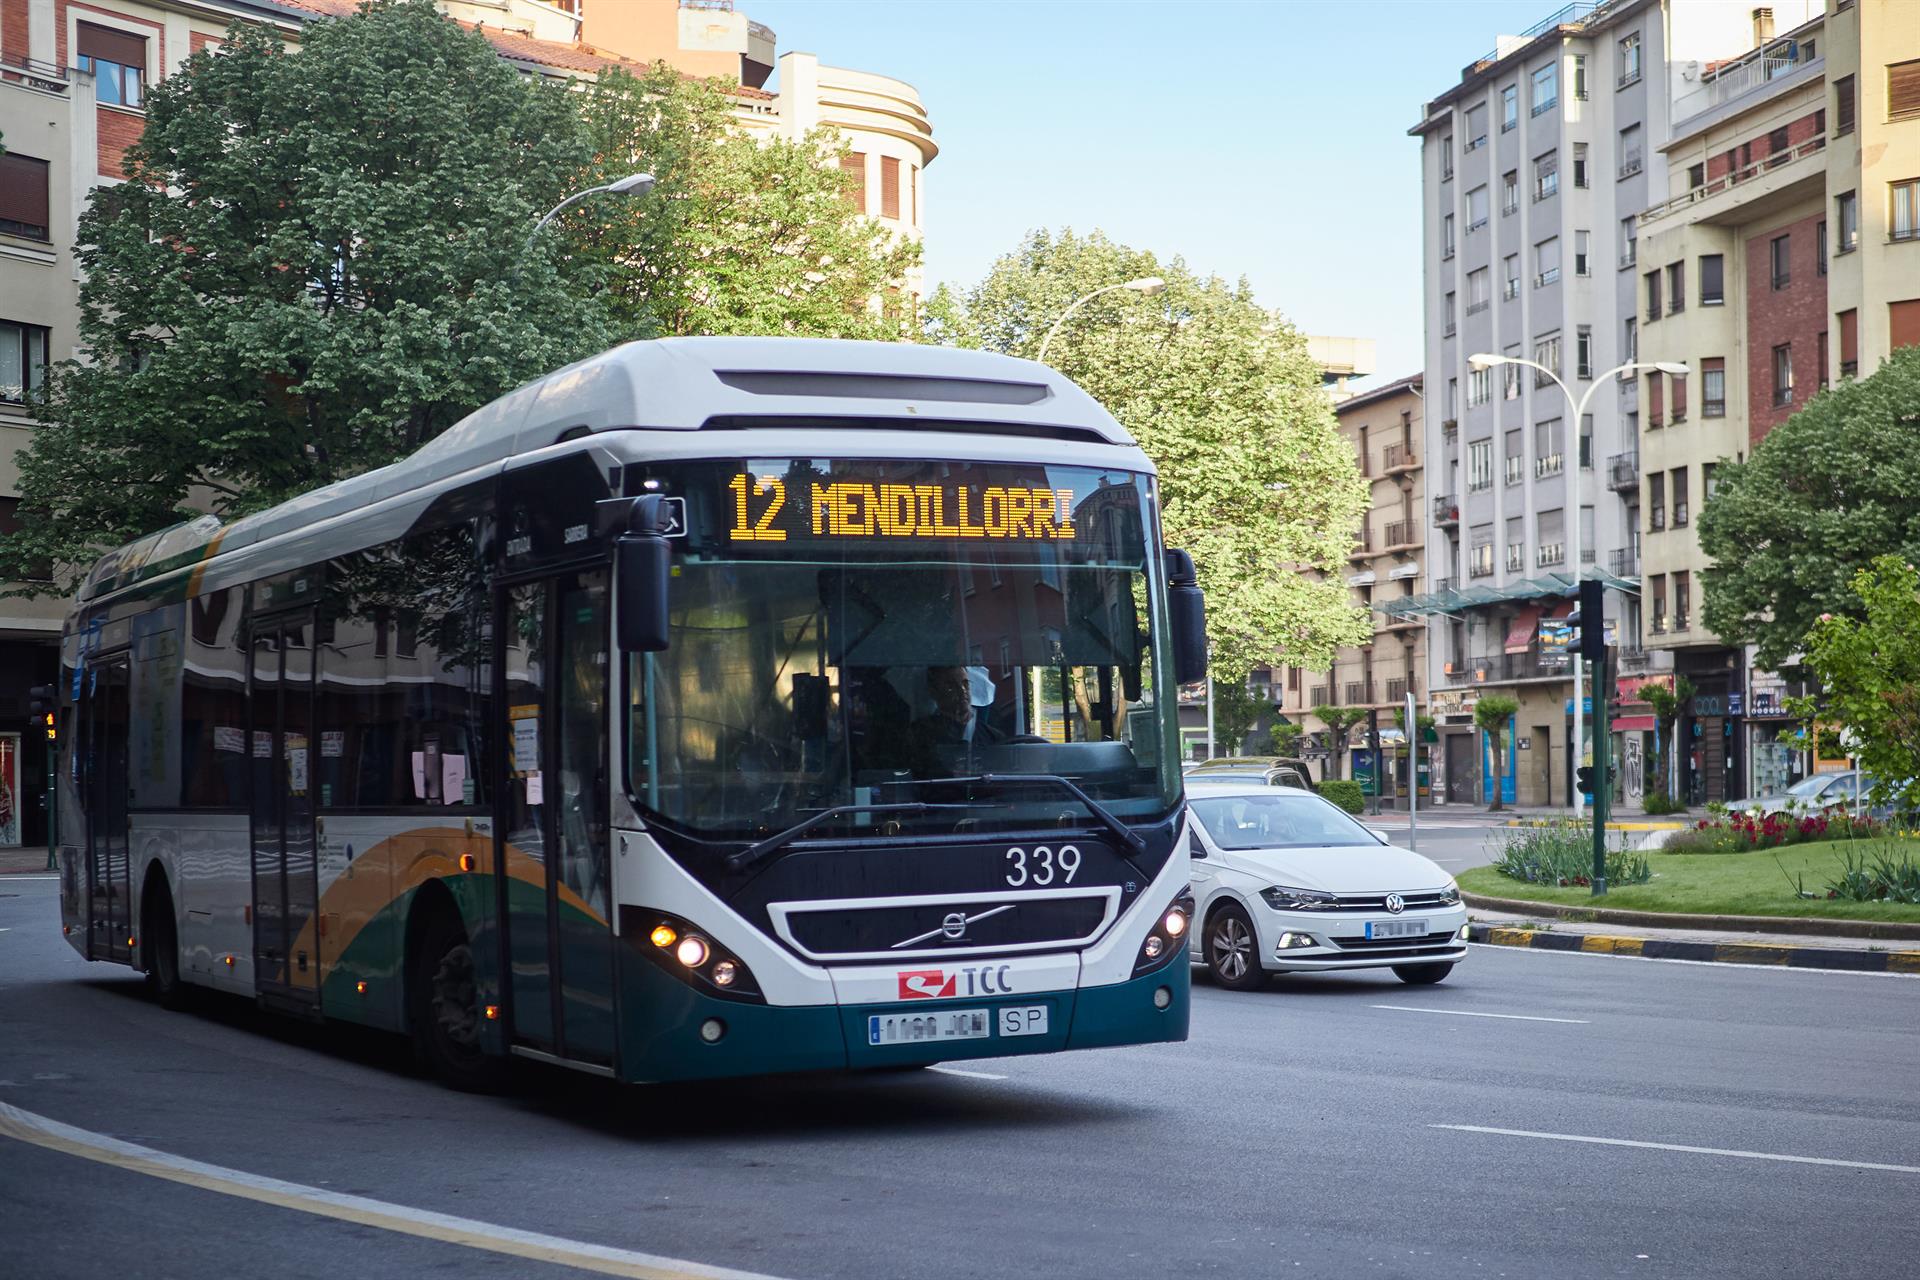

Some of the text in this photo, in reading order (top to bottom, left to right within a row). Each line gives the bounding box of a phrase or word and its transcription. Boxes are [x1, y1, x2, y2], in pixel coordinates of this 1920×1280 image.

[729, 474, 1075, 541] 12 MENDILLORRI
[1006, 845, 1081, 887] 339
[962, 965, 1012, 996] TCC
